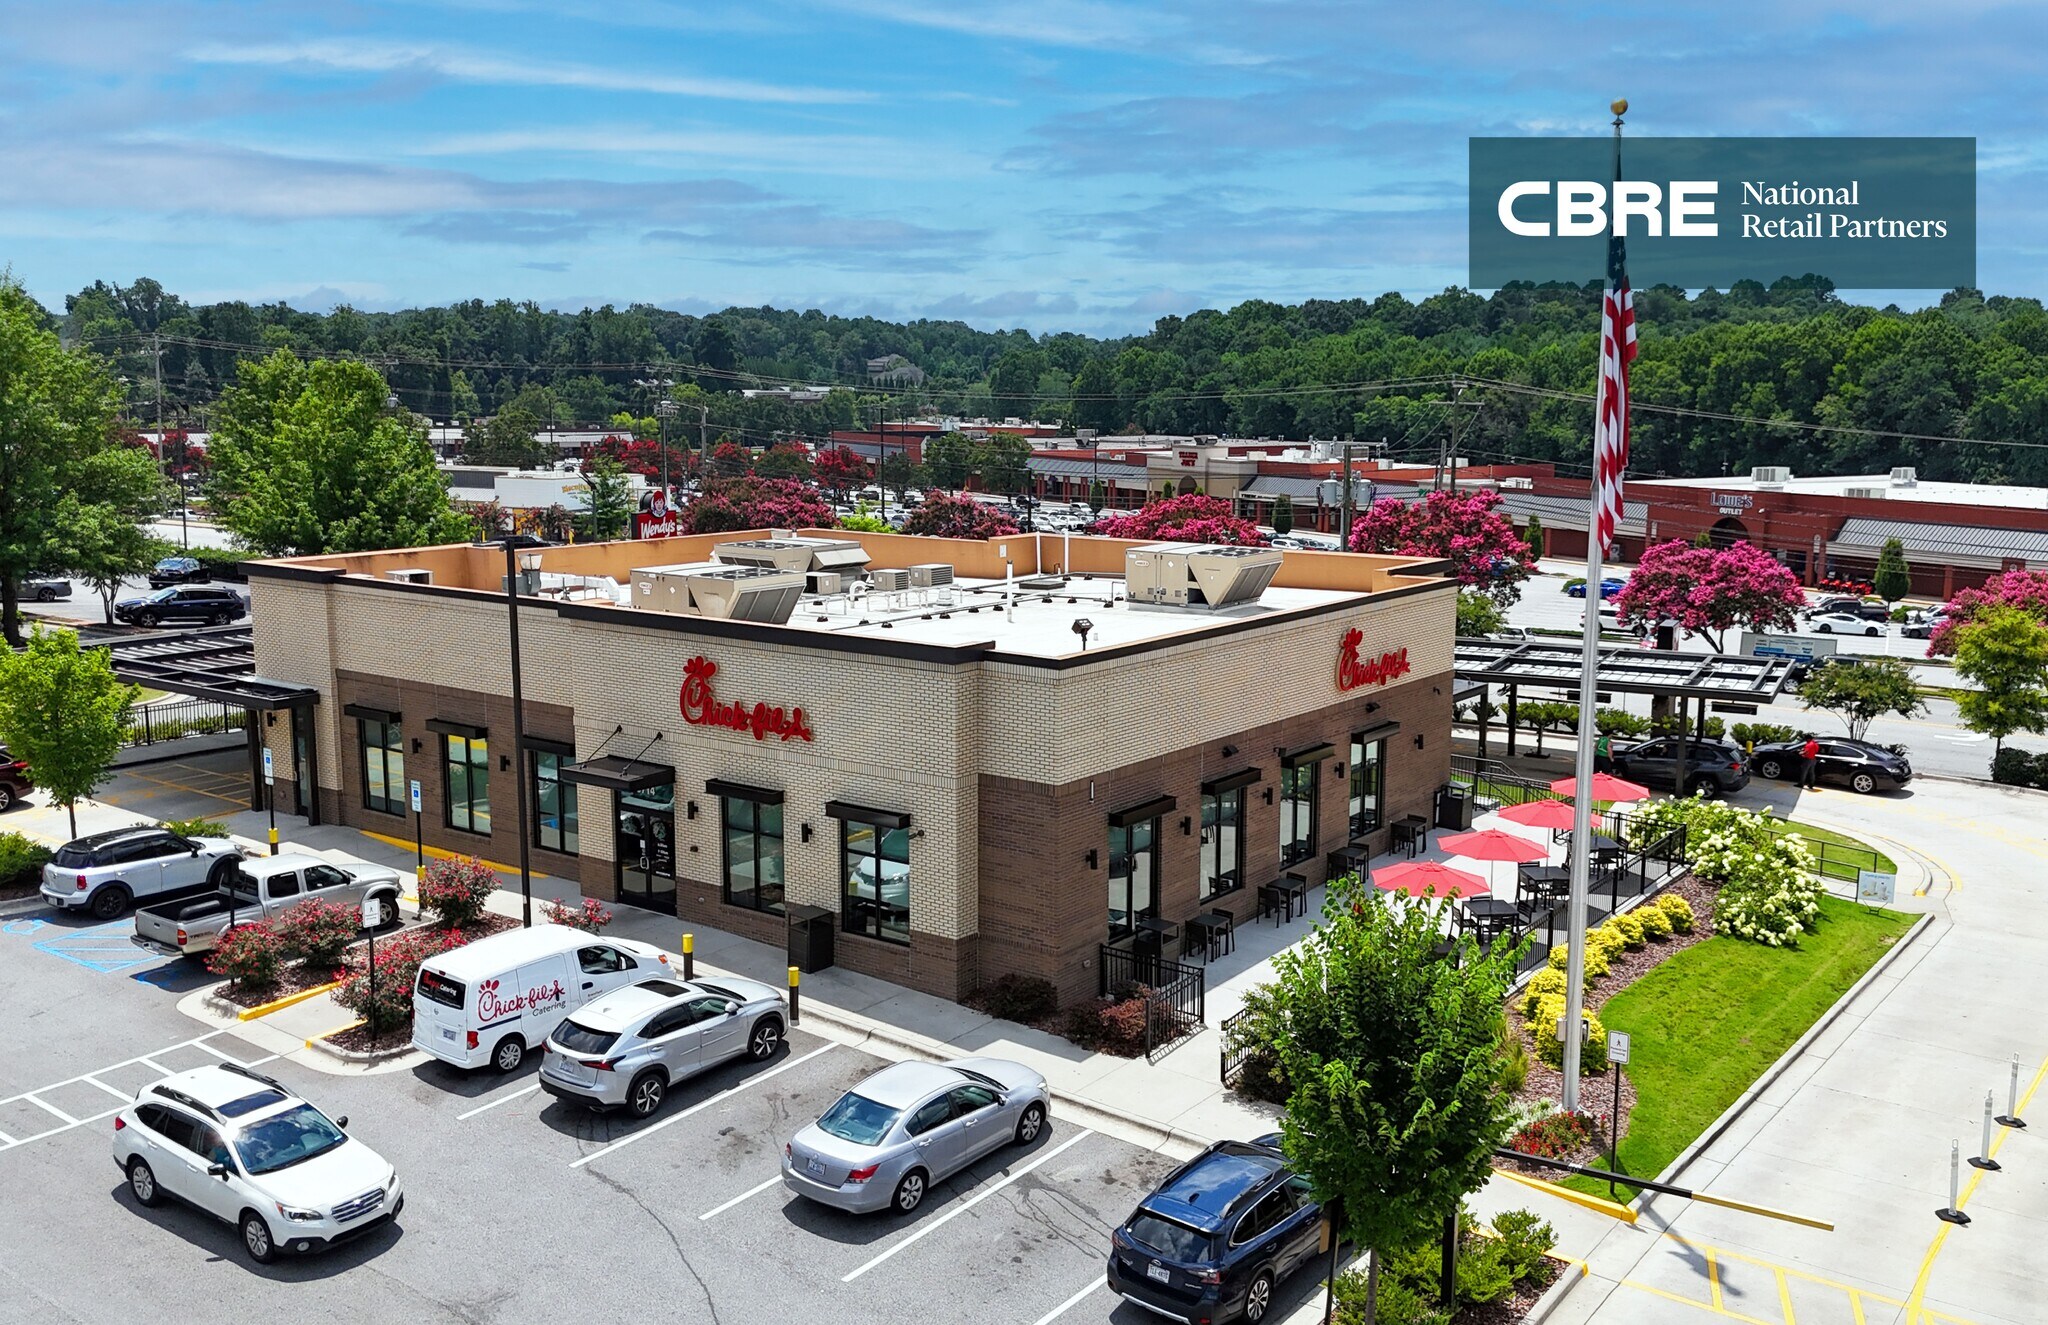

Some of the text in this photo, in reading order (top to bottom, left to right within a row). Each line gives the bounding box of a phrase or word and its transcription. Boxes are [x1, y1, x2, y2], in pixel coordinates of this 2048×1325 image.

[1719, 507, 1743, 516] OUTLET
[640, 516, 676, 539] Wendy's
[680, 655, 812, 741] Chick-fil-A
[478, 979, 566, 1022] Chick-fil-A
[532, 1000, 567, 1017] Catering
